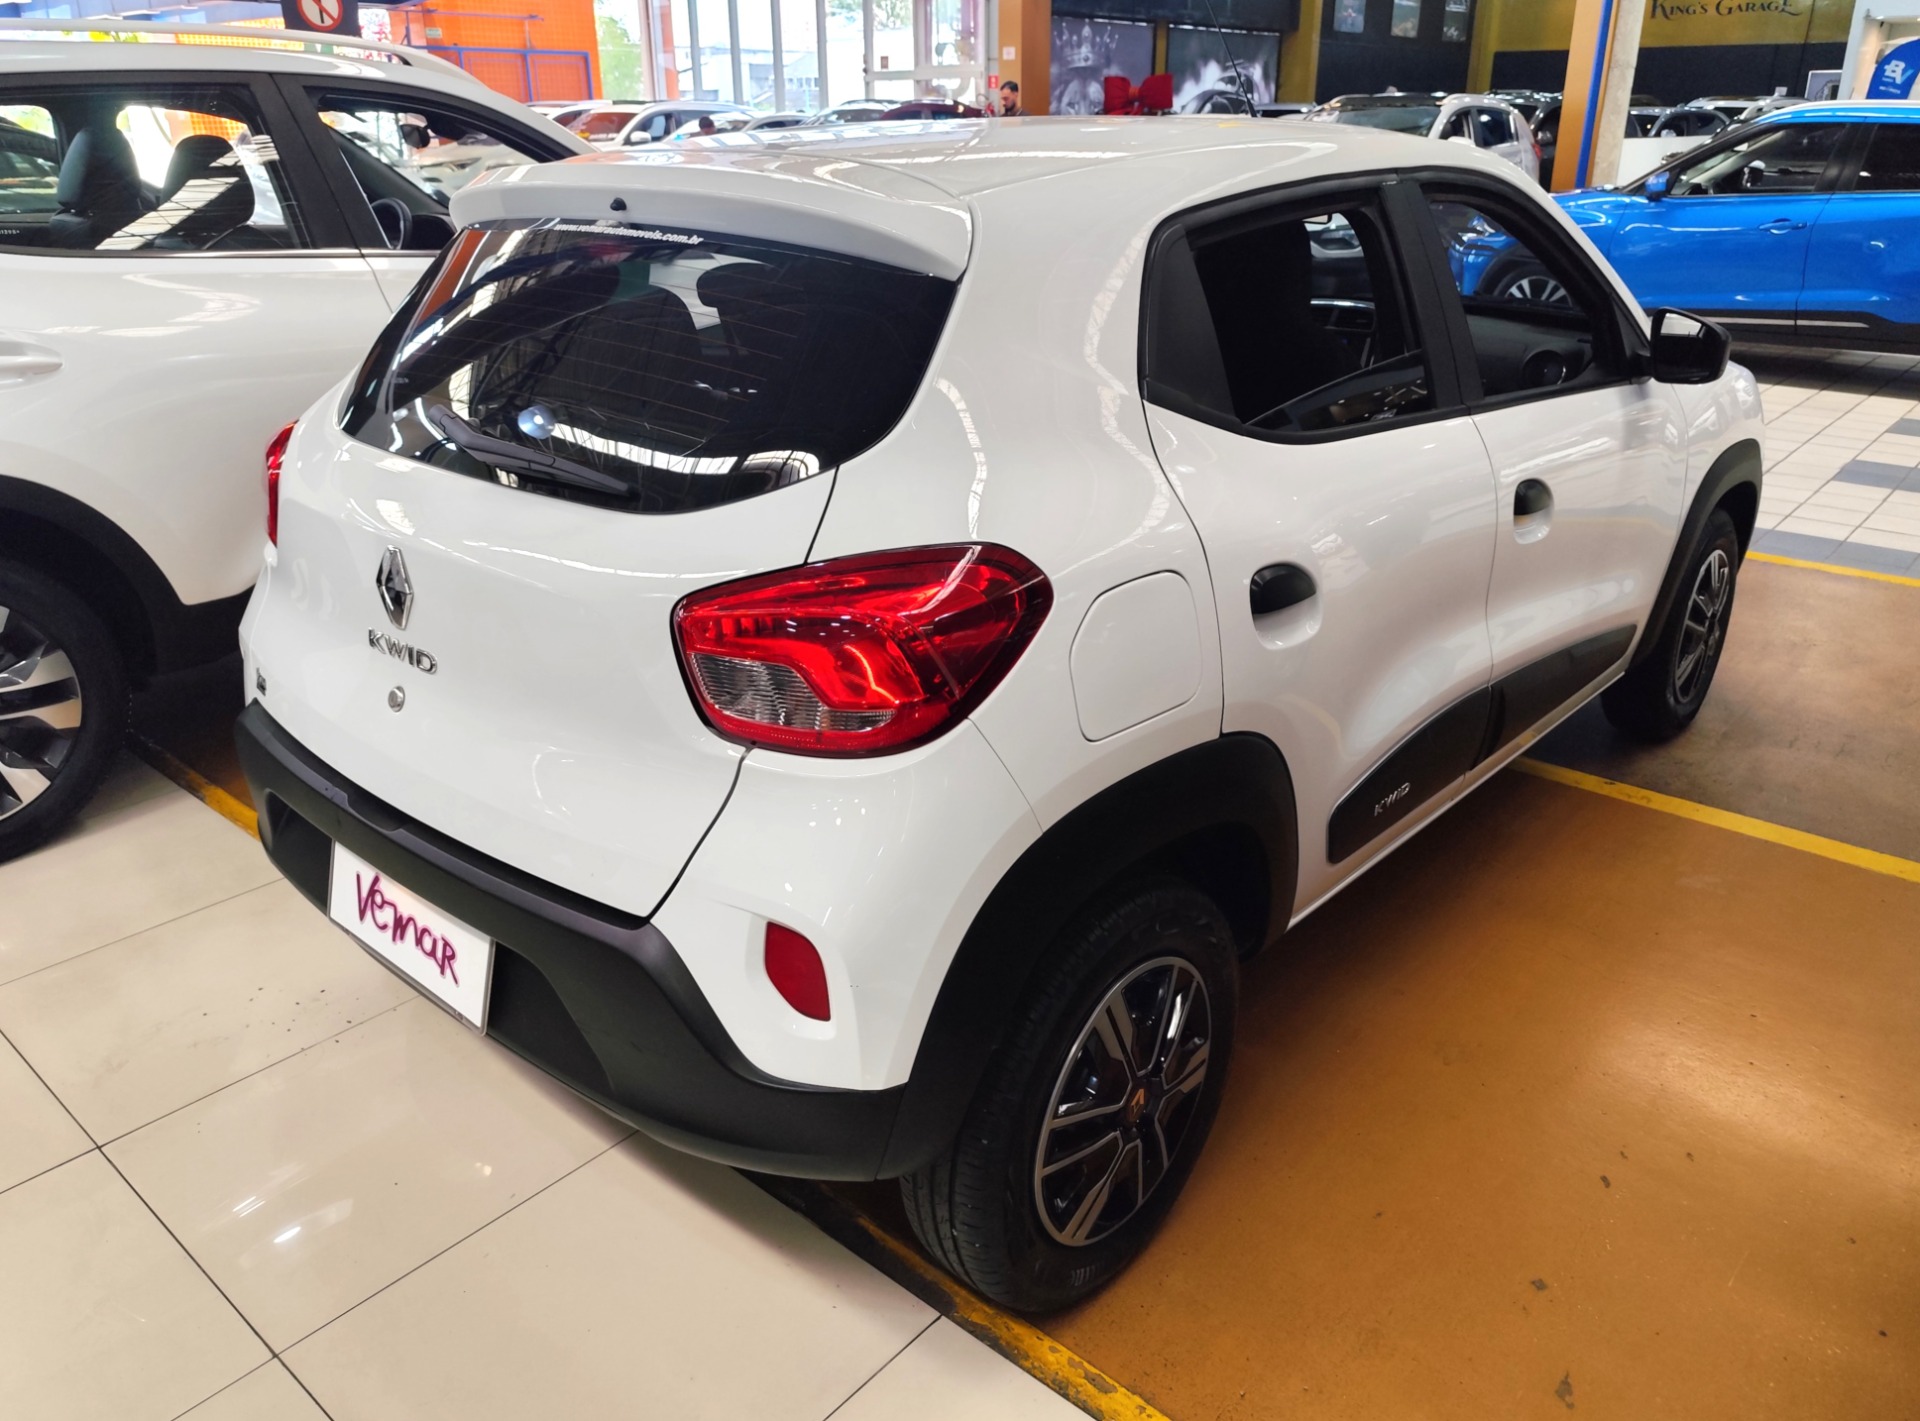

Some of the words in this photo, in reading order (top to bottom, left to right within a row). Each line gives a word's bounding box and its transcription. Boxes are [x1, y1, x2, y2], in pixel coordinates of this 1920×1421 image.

[1715, 0, 1803, 16] GARAGE
[368, 627, 438, 675] KWID
[1374, 782, 1411, 817] KWID
